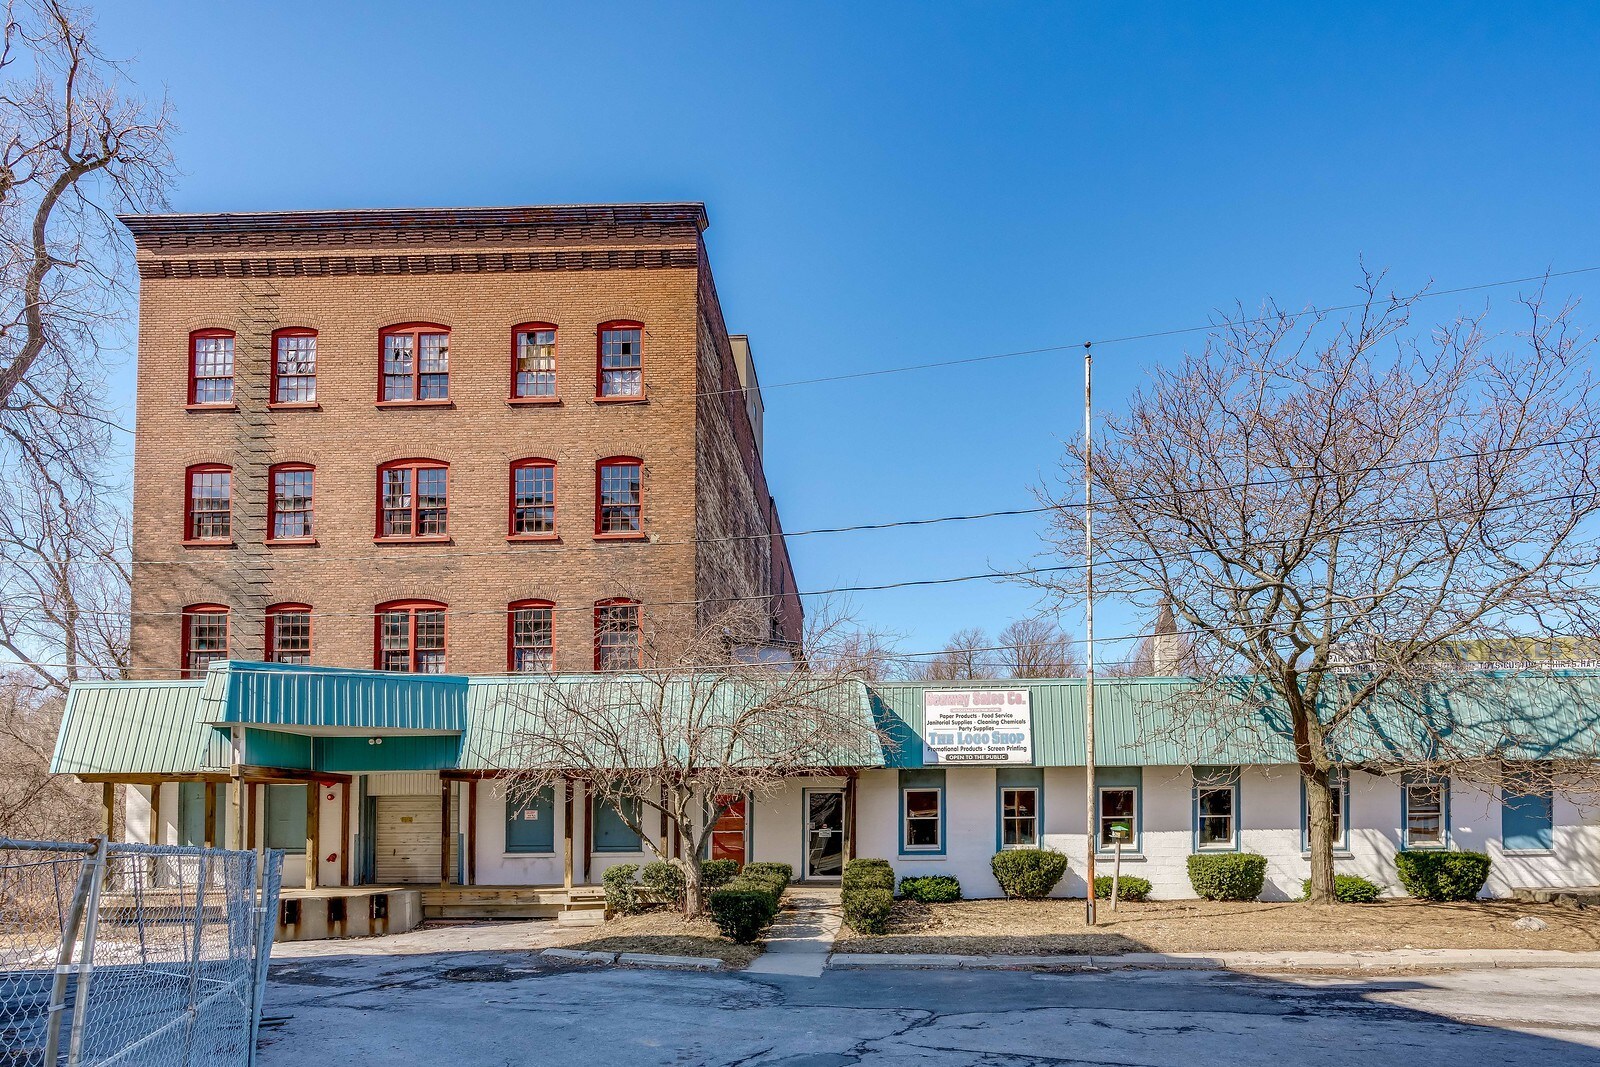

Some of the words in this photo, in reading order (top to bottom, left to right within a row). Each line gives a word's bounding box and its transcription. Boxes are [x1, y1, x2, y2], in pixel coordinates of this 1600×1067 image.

[972, 691, 1005, 706] Sales
[928, 732, 954, 745] THE
[957, 731, 990, 745] LOGO
[991, 731, 1025, 745] SHOP
